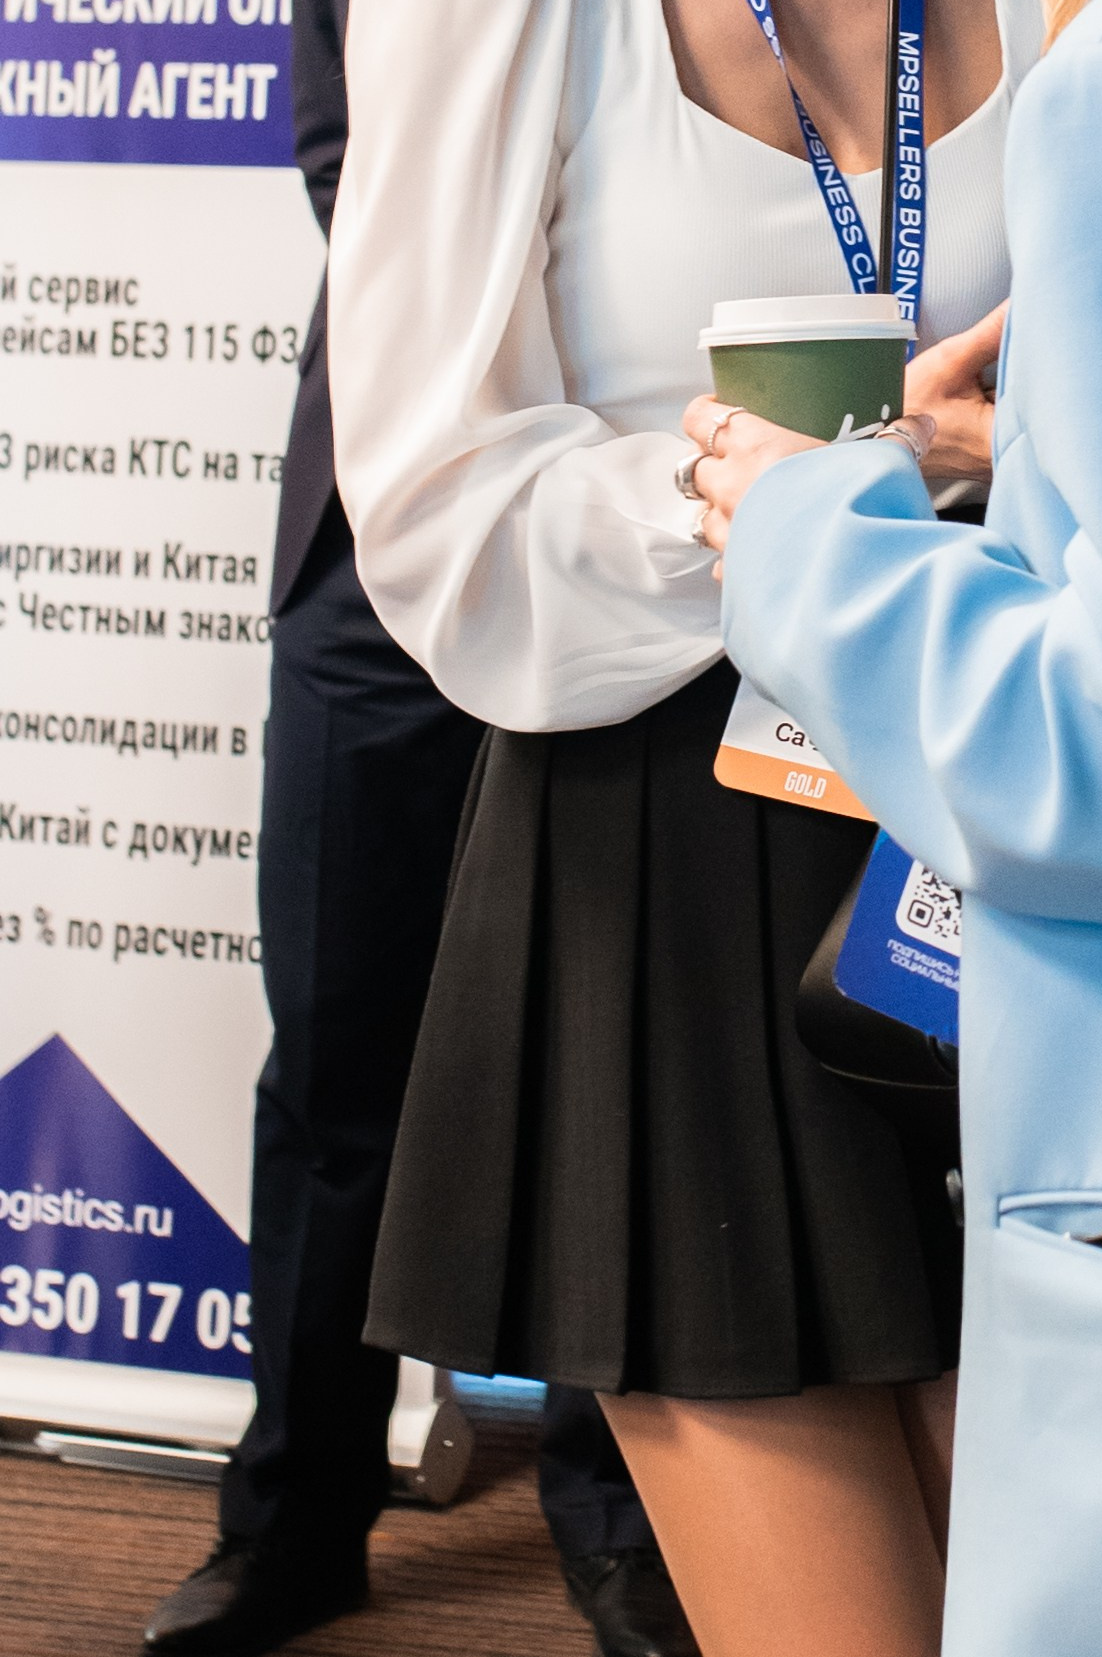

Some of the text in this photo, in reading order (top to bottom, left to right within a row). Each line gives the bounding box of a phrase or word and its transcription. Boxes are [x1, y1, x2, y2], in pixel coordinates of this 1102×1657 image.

[128, 61, 279, 120] АГЕНТ
[897, 31, 922, 201] MPSELLERS
[28, 274, 140, 314] сервис
[111, 320, 169, 359] БЕЗ
[184, 324, 239, 362] 115
[25, 443, 116, 481] риска
[129, 439, 191, 480] КТС
[203, 450, 238, 483] на
[134, 551, 150, 578] и
[163, 543, 258, 586] Китая
[19, 592, 166, 637] Честным
[0, 710, 248, 761] онсолидации в
[784, 770, 827, 799] GOLD
[0, 803, 251, 866] Китай с докуме
[67, 918, 103, 949] по
[0, 1265, 99, 1335] 350
[117, 1281, 183, 1344] 17
